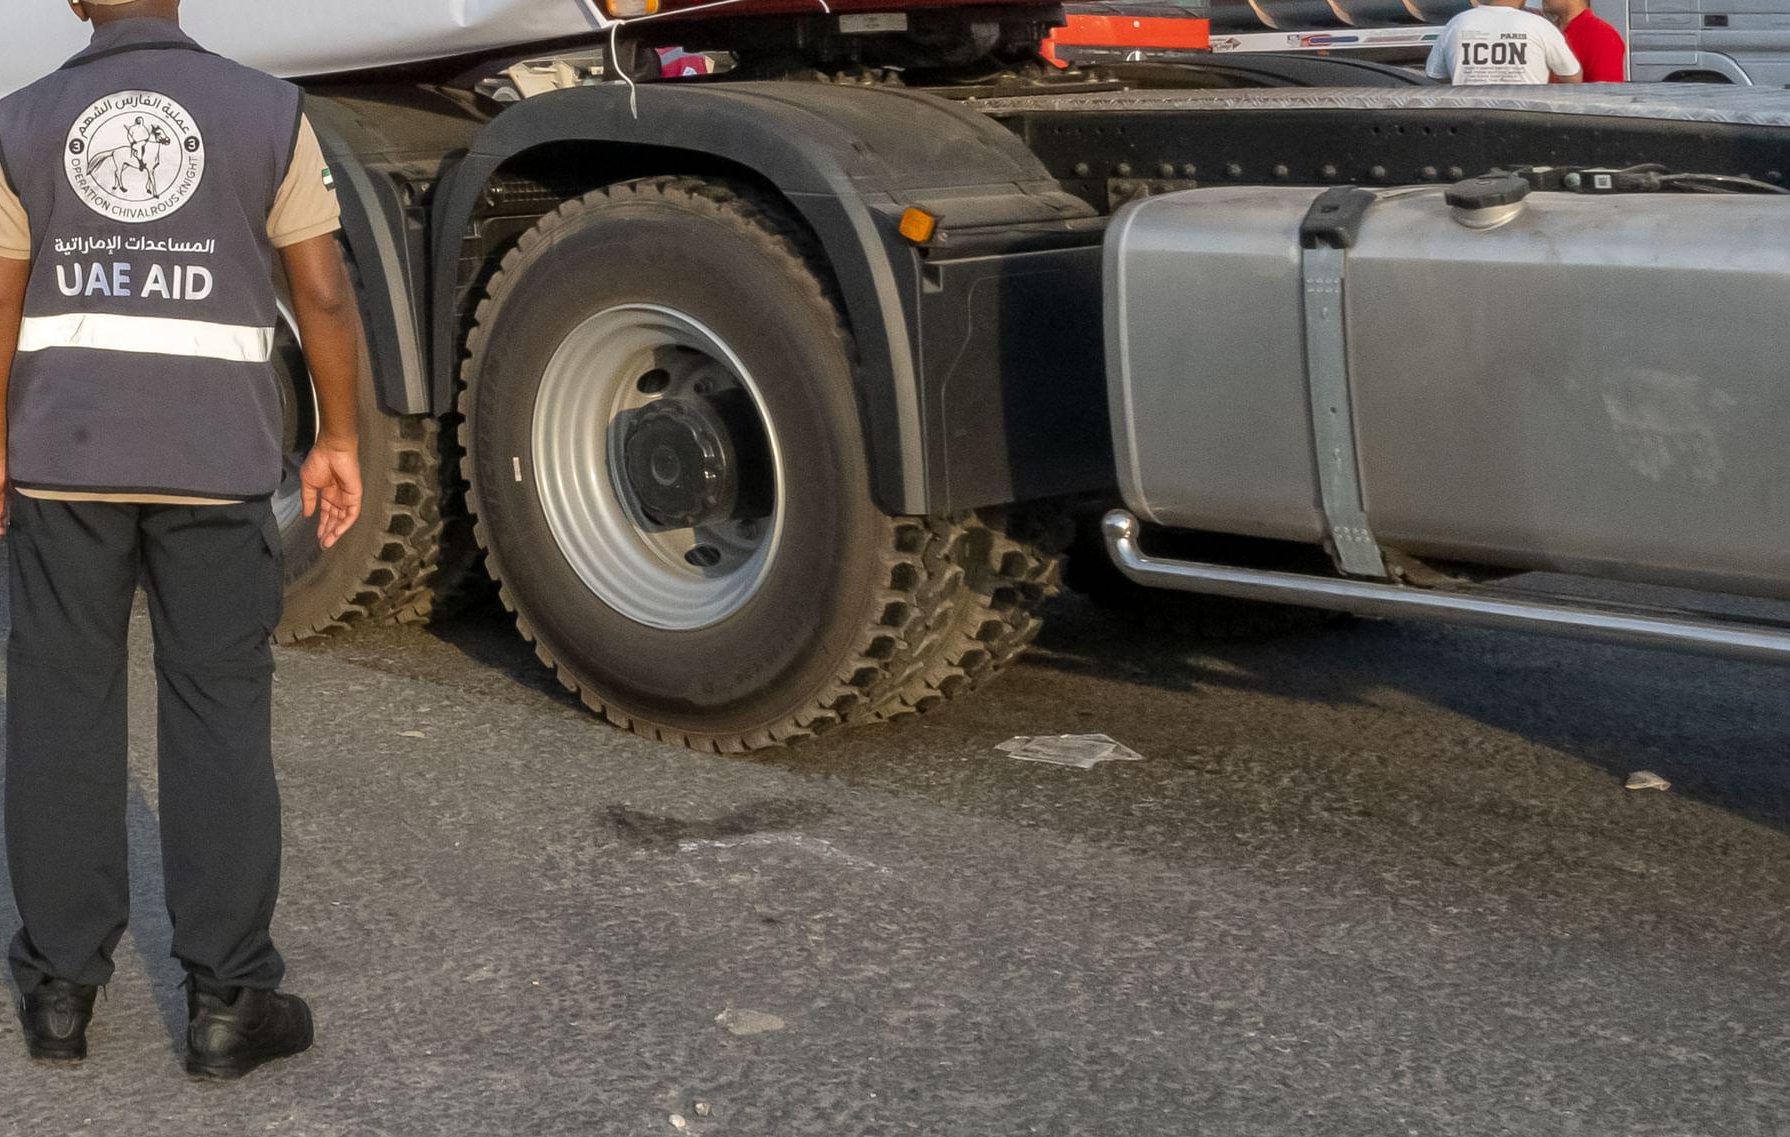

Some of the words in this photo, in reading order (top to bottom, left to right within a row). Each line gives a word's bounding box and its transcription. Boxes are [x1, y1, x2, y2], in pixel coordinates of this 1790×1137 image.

[1461, 42, 1527, 65] ICON
[115, 93, 161, 110] الفارس
[77, 100, 112, 139] الشهم
[161, 102, 191, 135] عملية
[71, 158, 111, 211] OPERATION
[111, 193, 181, 219] CHIVALROUS
[179, 156, 199, 200] KNIGHT
[54, 235, 122, 255] الإماراتية
[124, 236, 215, 254] المساعدات
[55, 261, 132, 297] UAE
[140, 263, 214, 300] AID
